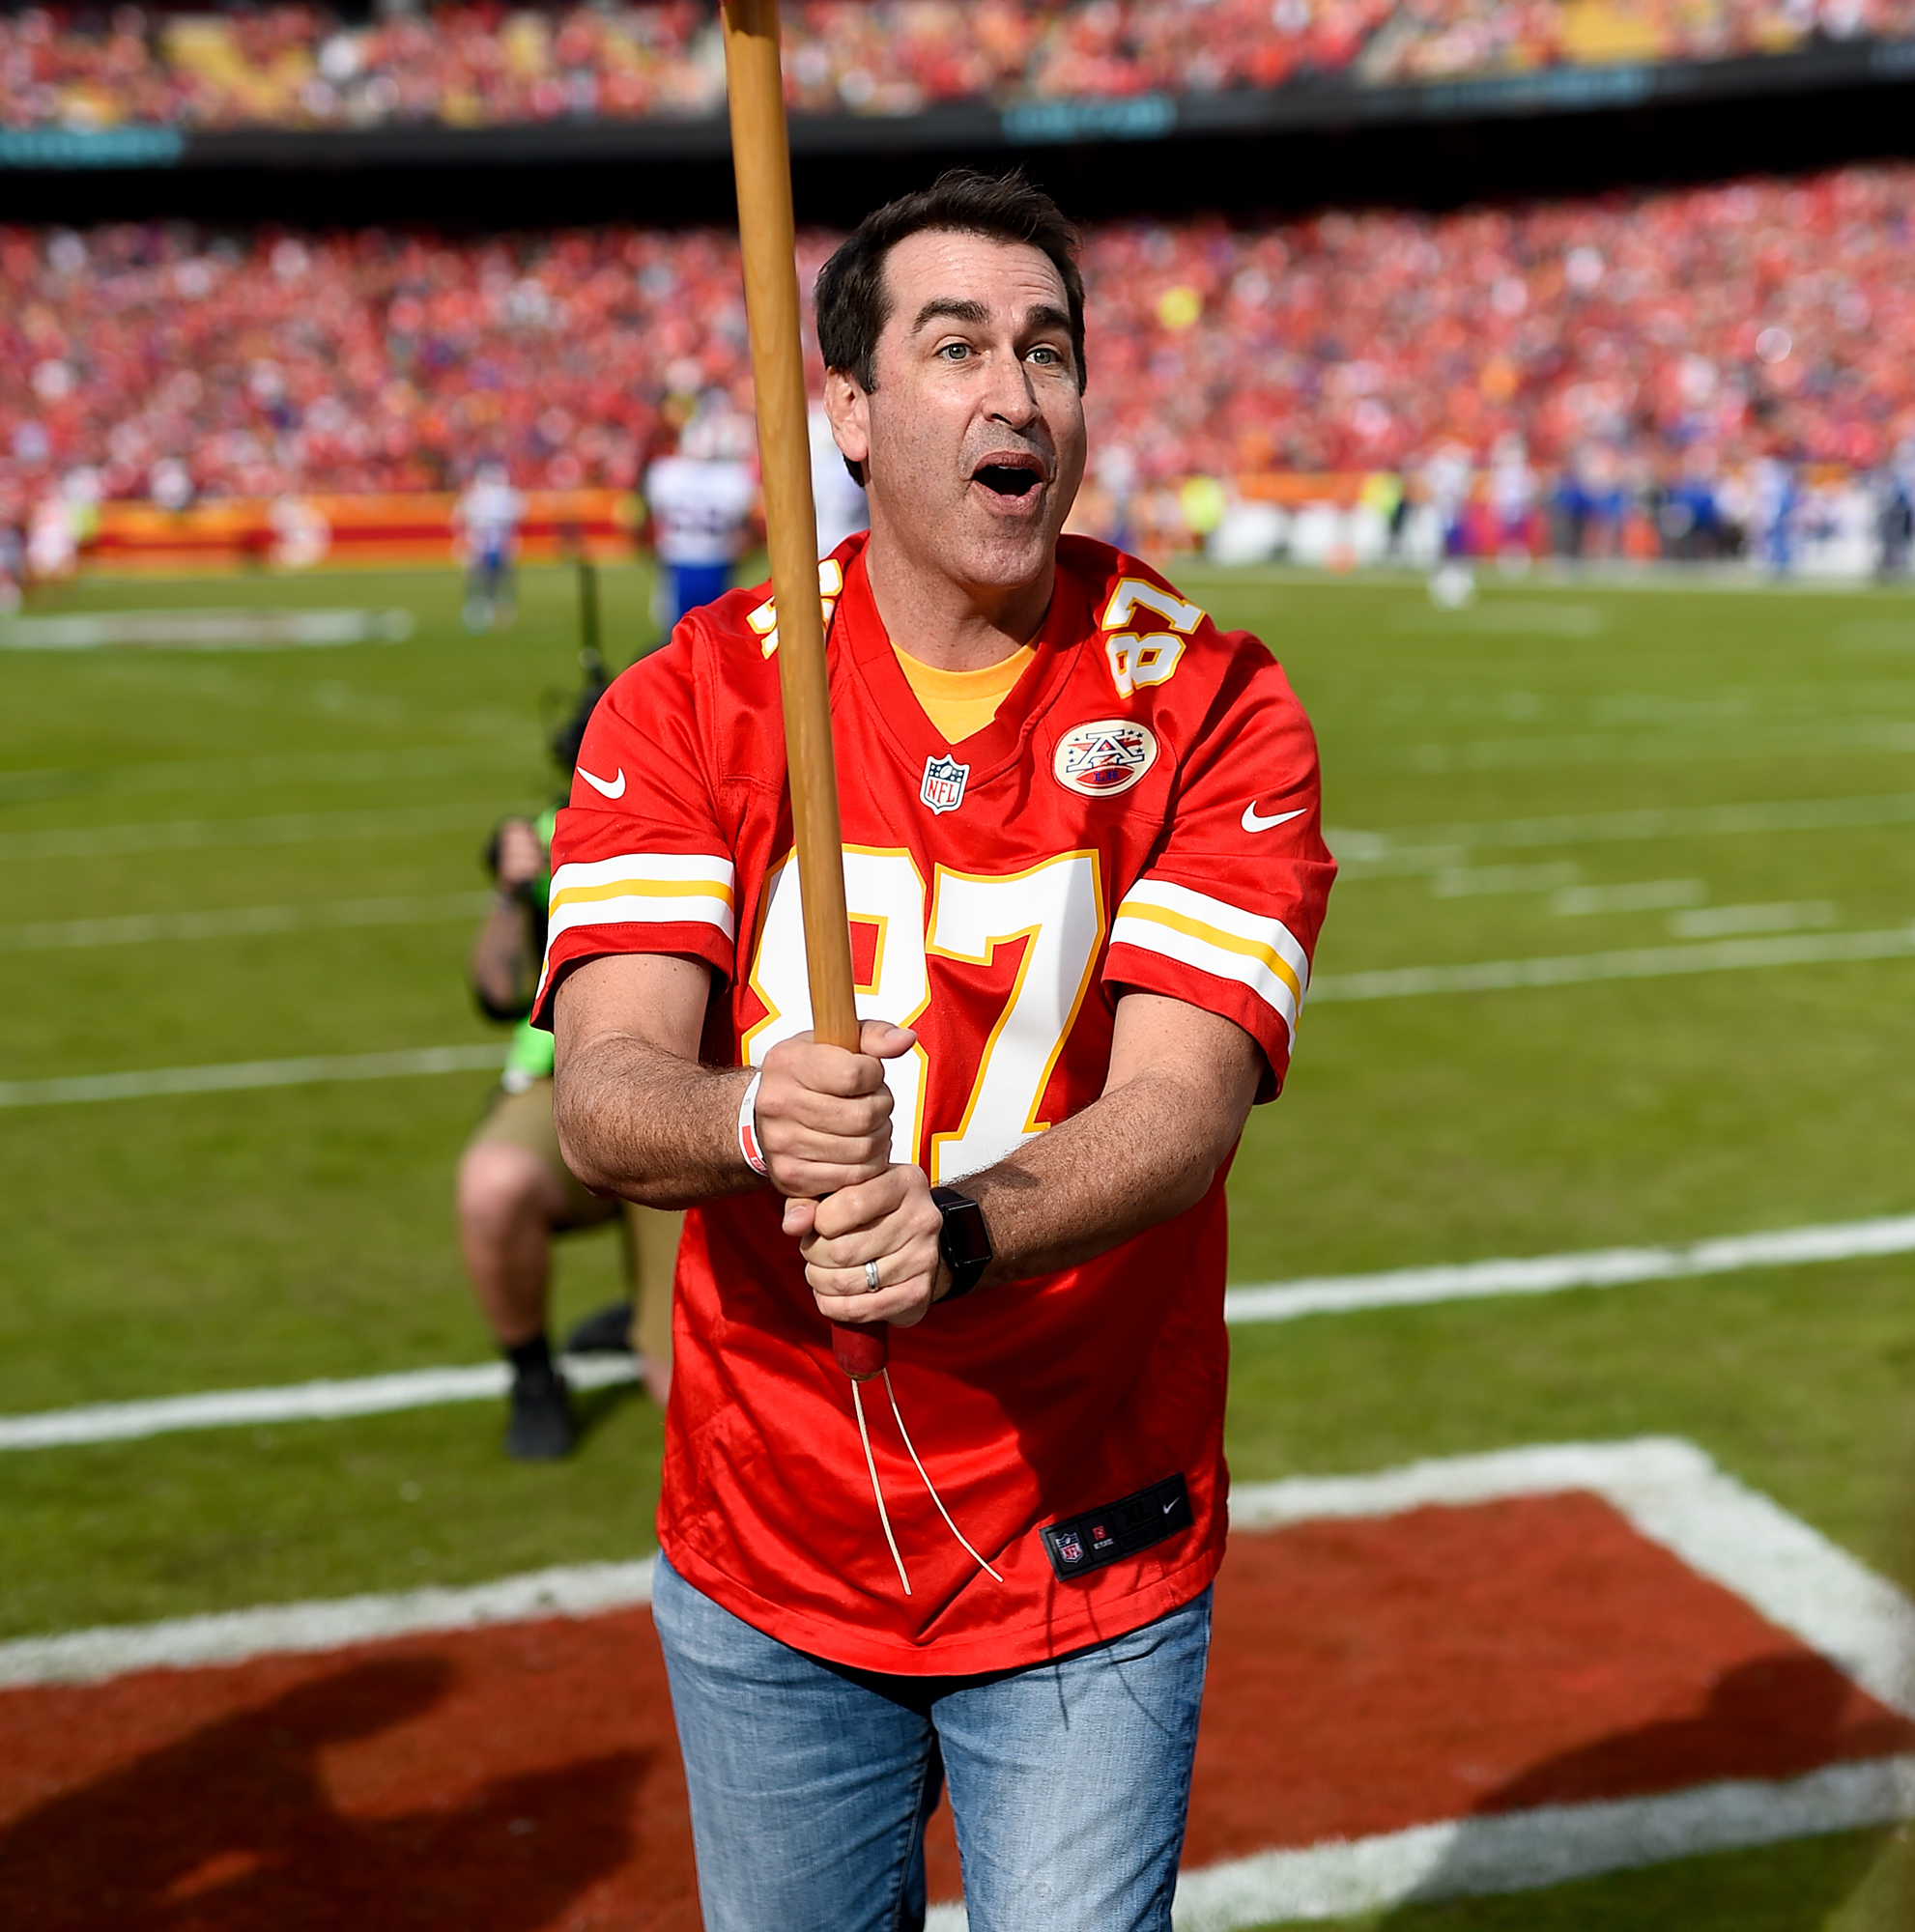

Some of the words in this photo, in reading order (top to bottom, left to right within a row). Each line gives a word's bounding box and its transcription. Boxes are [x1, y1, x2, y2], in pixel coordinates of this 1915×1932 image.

[1101, 577, 1206, 699] 87
[1094, 770, 1119, 782] LH
[927, 779, 956, 804] NFL
[741, 842, 1105, 1188] 87
[1120, 1501, 1154, 1529] XL
